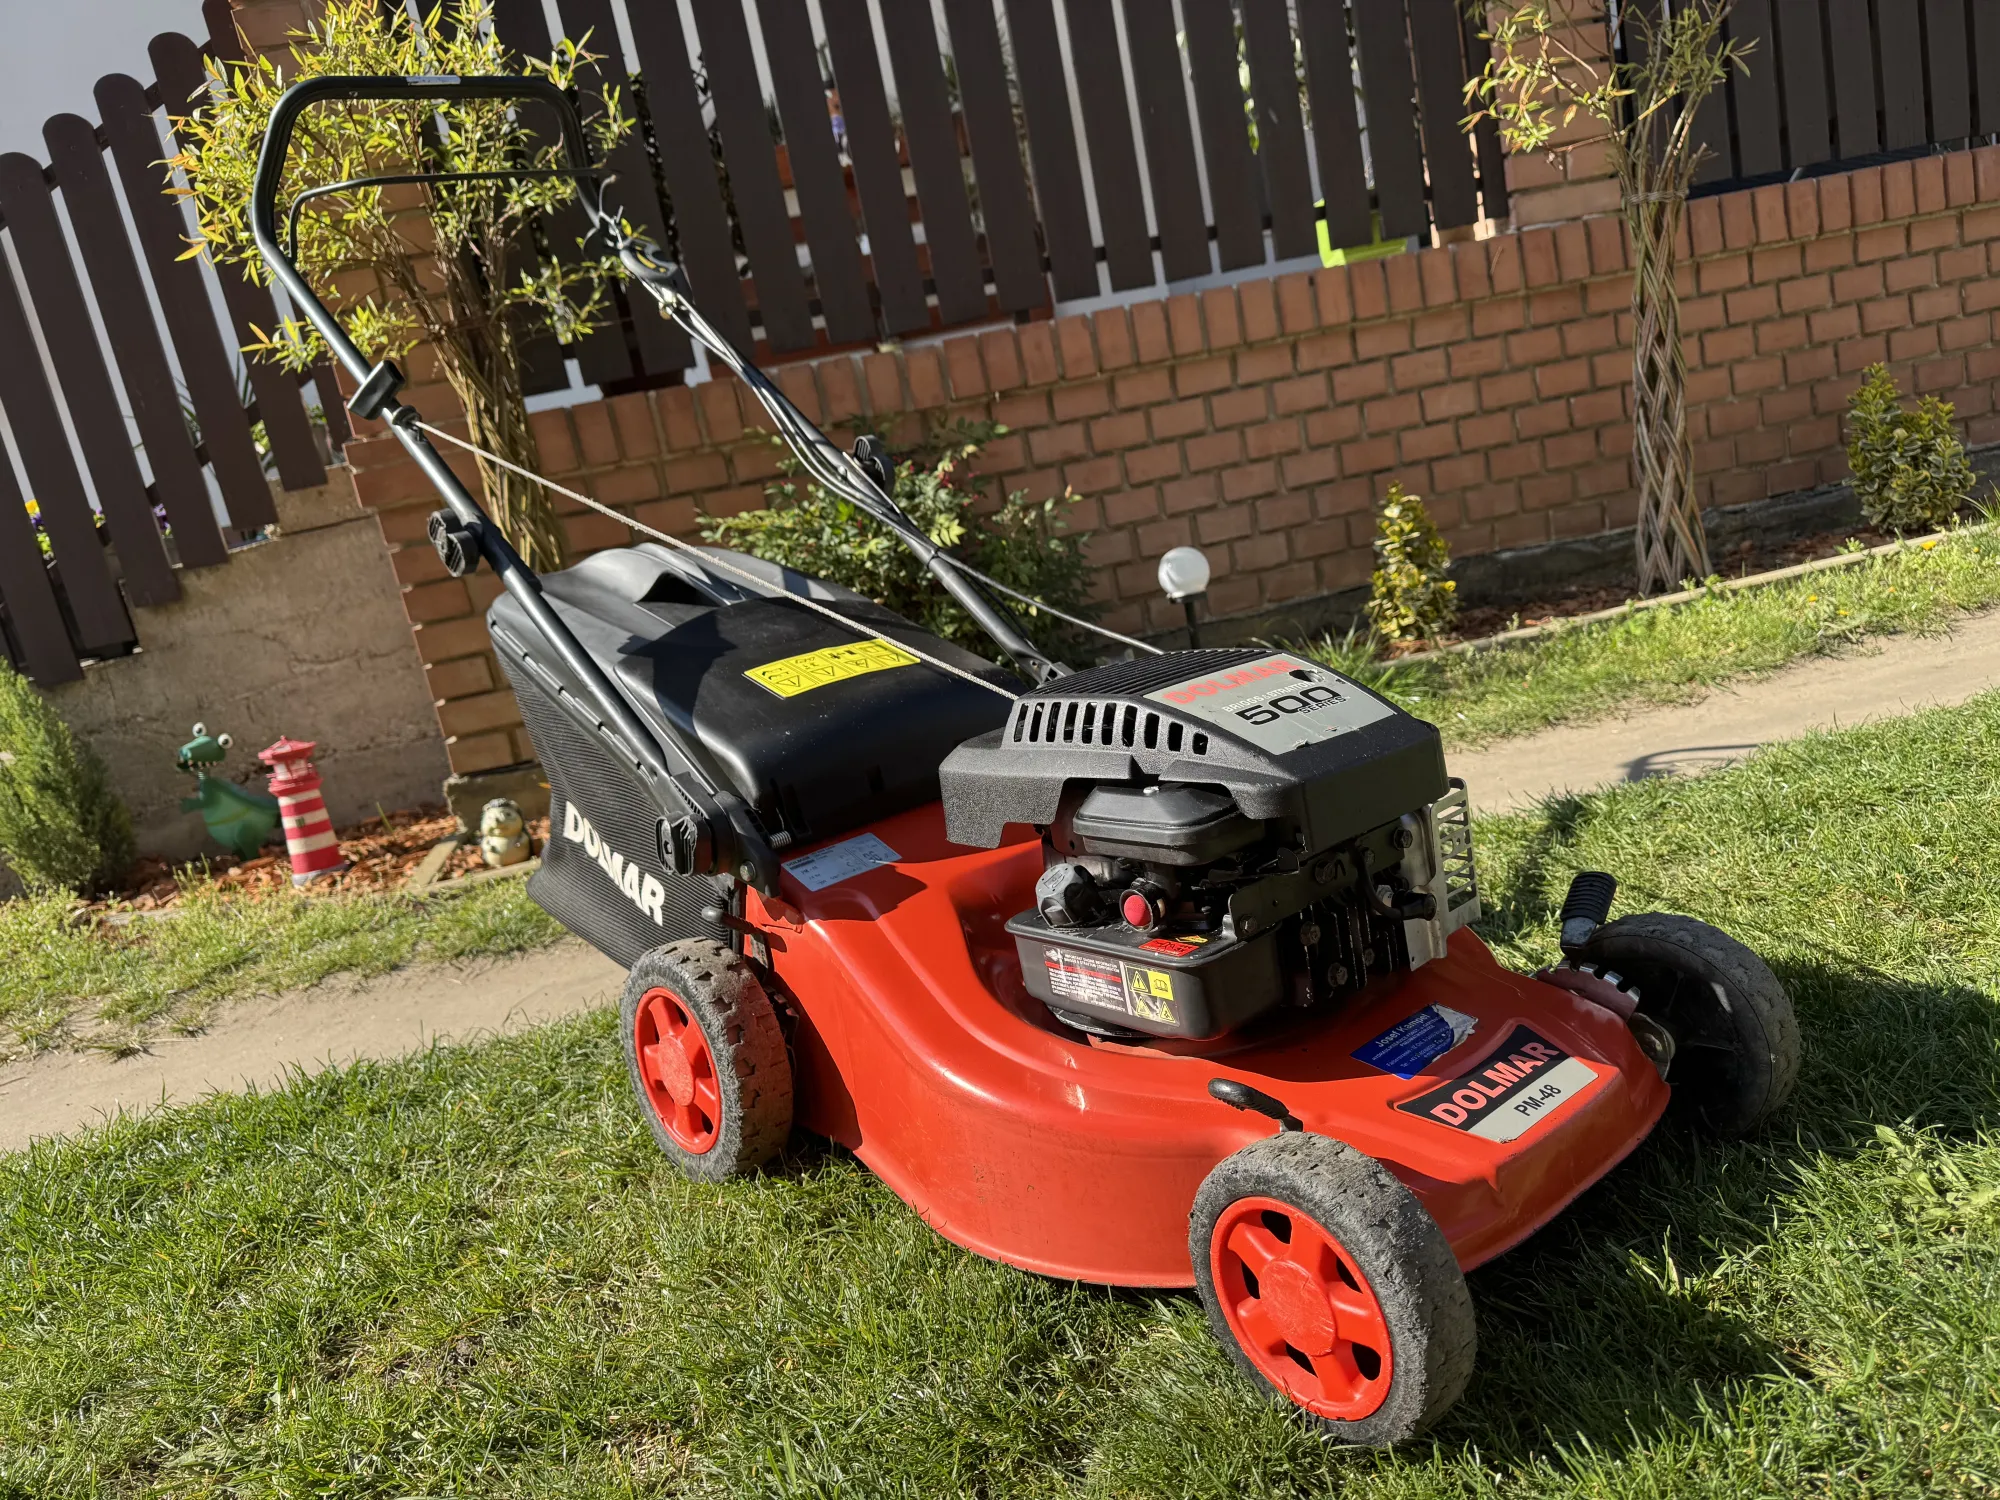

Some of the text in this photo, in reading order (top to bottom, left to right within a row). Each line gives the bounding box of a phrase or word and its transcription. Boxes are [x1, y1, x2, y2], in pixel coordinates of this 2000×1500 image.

[1162, 659, 1300, 705] DOLMAR
[1234, 685, 1342, 726] 500
[1298, 695, 1347, 714] SERIES
[1375, 1030, 1401, 1048] Josef
[1398, 1013, 1431, 1034] Kampel
[1430, 1042, 1560, 1126] DOLMAR
[1514, 1084, 1562, 1117] PM-48
